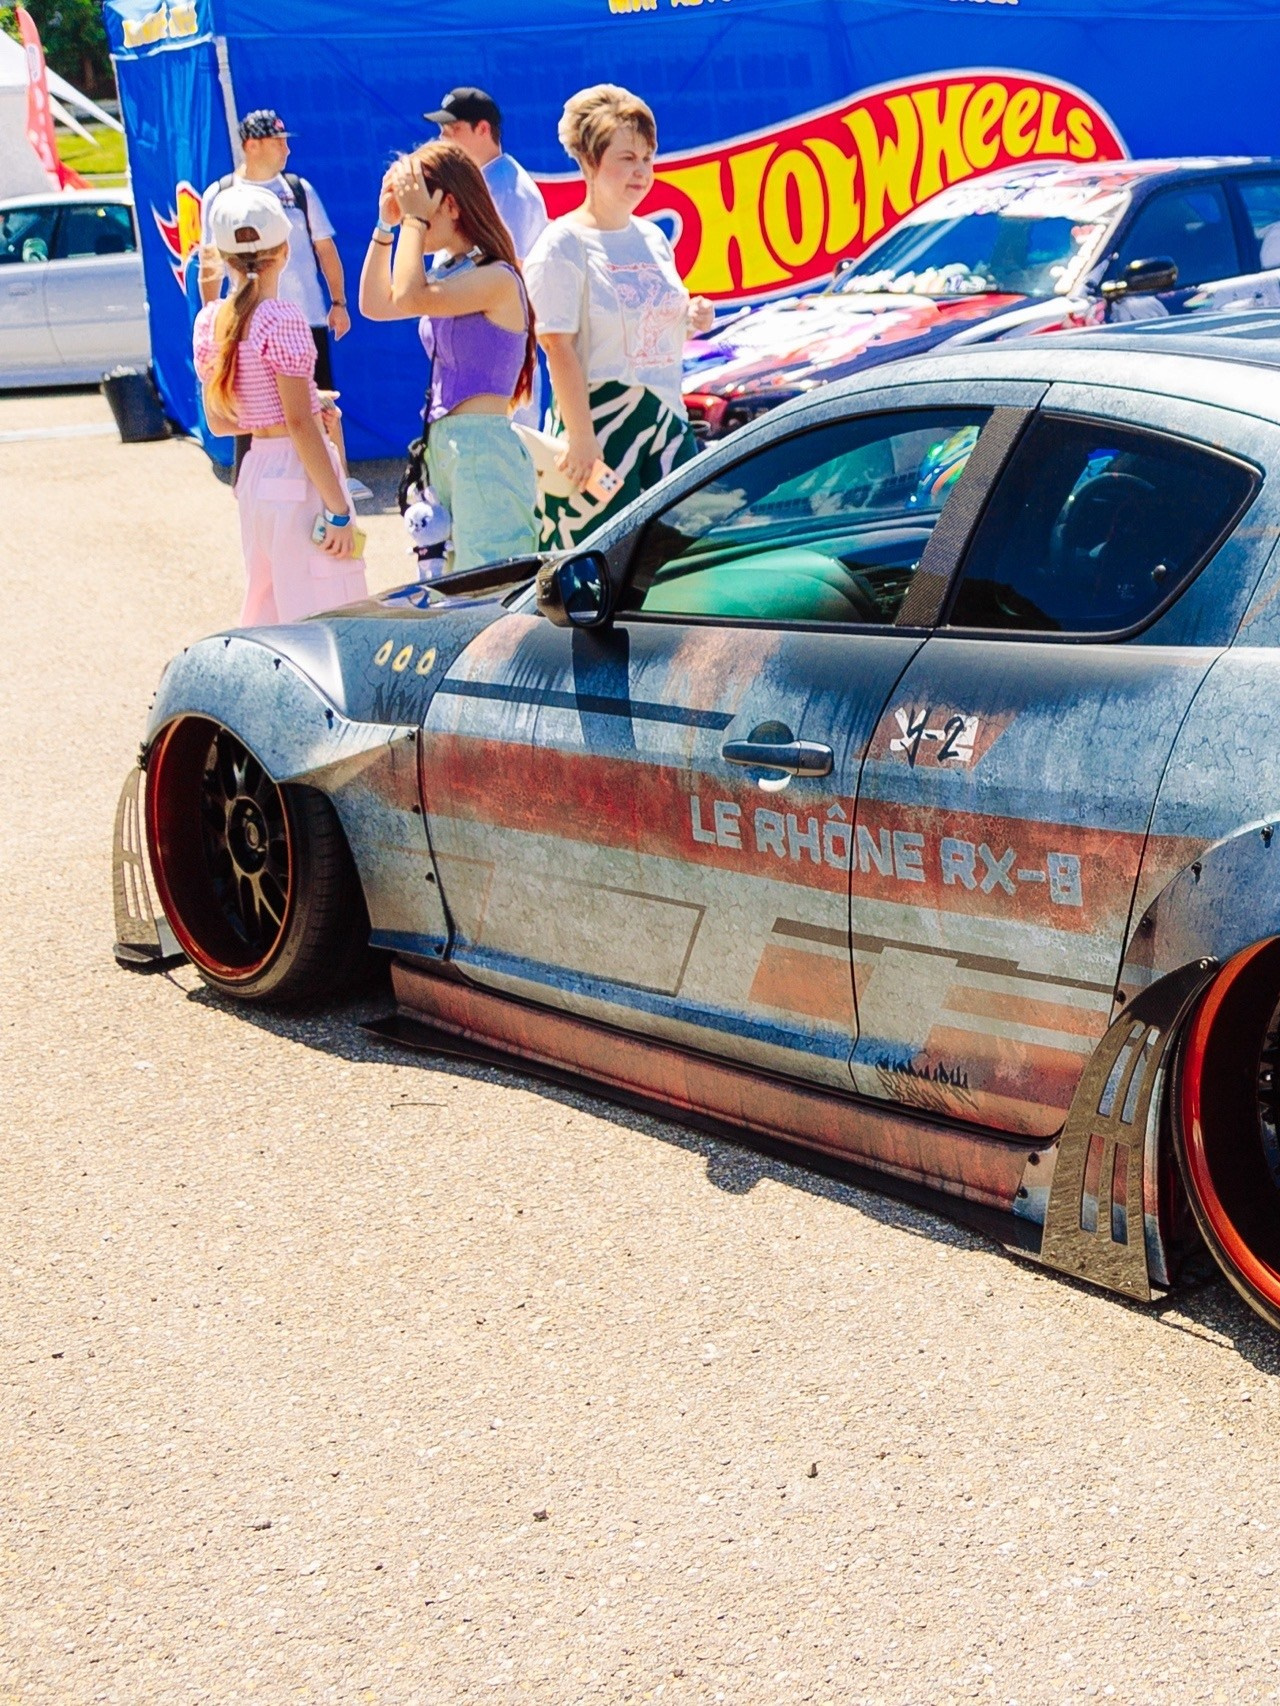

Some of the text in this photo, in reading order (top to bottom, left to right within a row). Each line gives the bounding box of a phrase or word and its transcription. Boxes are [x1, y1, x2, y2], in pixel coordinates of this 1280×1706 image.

[653, 138, 860, 294] HOT
[691, 796, 742, 849] LE
[754, 804, 926, 883] RHÔNE
